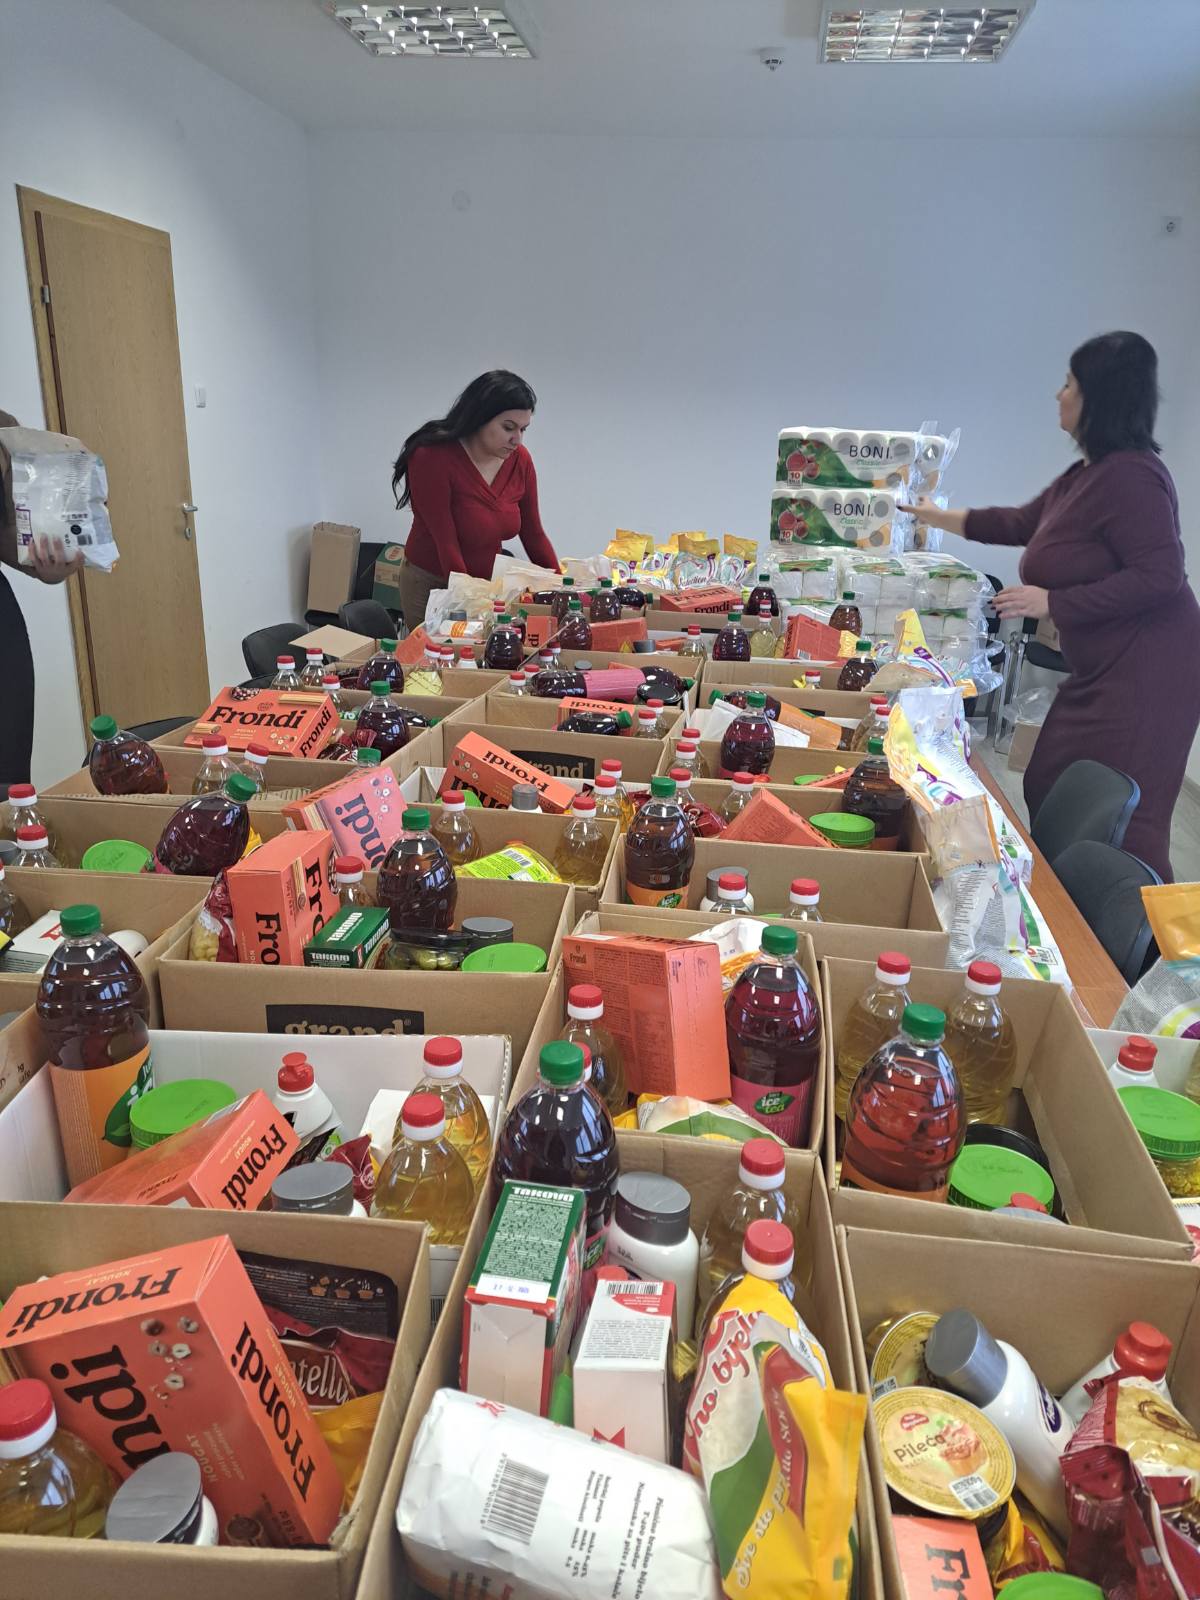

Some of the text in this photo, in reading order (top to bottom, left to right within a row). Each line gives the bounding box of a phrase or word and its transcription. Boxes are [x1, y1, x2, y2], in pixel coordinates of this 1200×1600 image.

[849, 444, 891, 460] BONI
[790, 472, 801, 480] 10
[833, 503, 871, 517] BONI
[782, 530, 793, 538] 10
[207, 706, 308, 729] Frondi
[299, 706, 332, 758] Frondi
[482, 750, 551, 794] Frondi
[534, 761, 585, 778] rand
[335, 793, 387, 869] ndi
[256, 911, 282, 965] Fro
[761, 1096, 781, 1107] ice
[221, 1123, 288, 1211] Frondi
[6, 1267, 183, 1338] Frondi
[50, 1344, 172, 1470] ndi
[230, 1321, 316, 1503] Frondi
[185, 1432, 219, 1483] NOUGAT
[893, 1432, 947, 1463] Pileća
